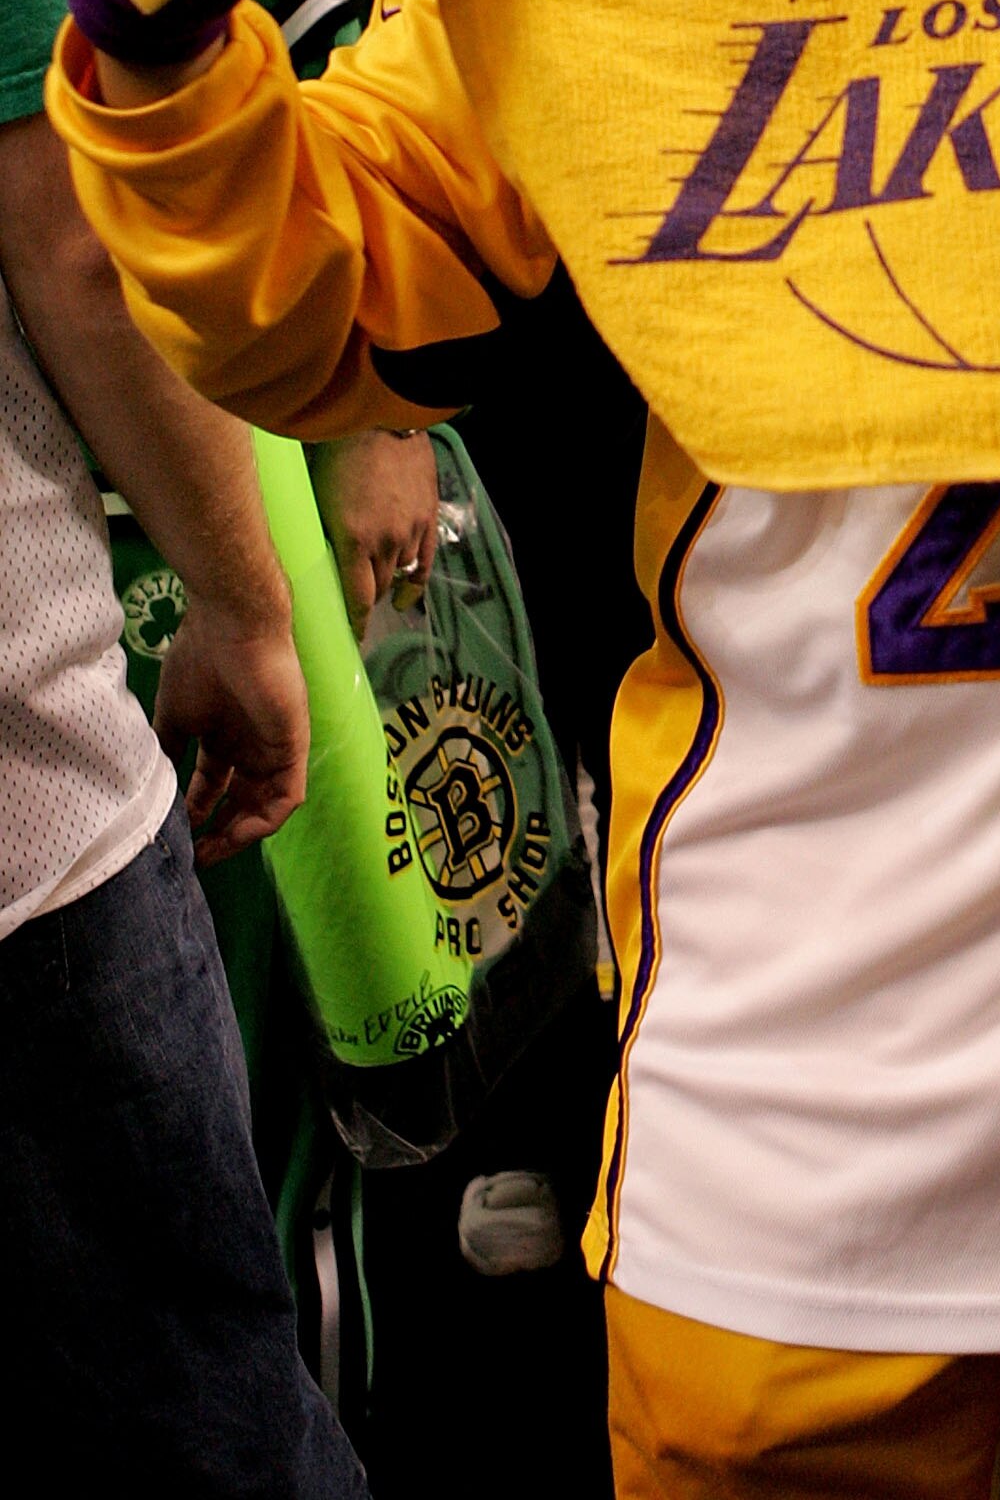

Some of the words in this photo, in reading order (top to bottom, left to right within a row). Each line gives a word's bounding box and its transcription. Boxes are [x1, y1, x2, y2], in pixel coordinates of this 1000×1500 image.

[384, 695, 431, 876] BOSON
[435, 909, 483, 958] PRO
[497, 811, 552, 929] SHOP
